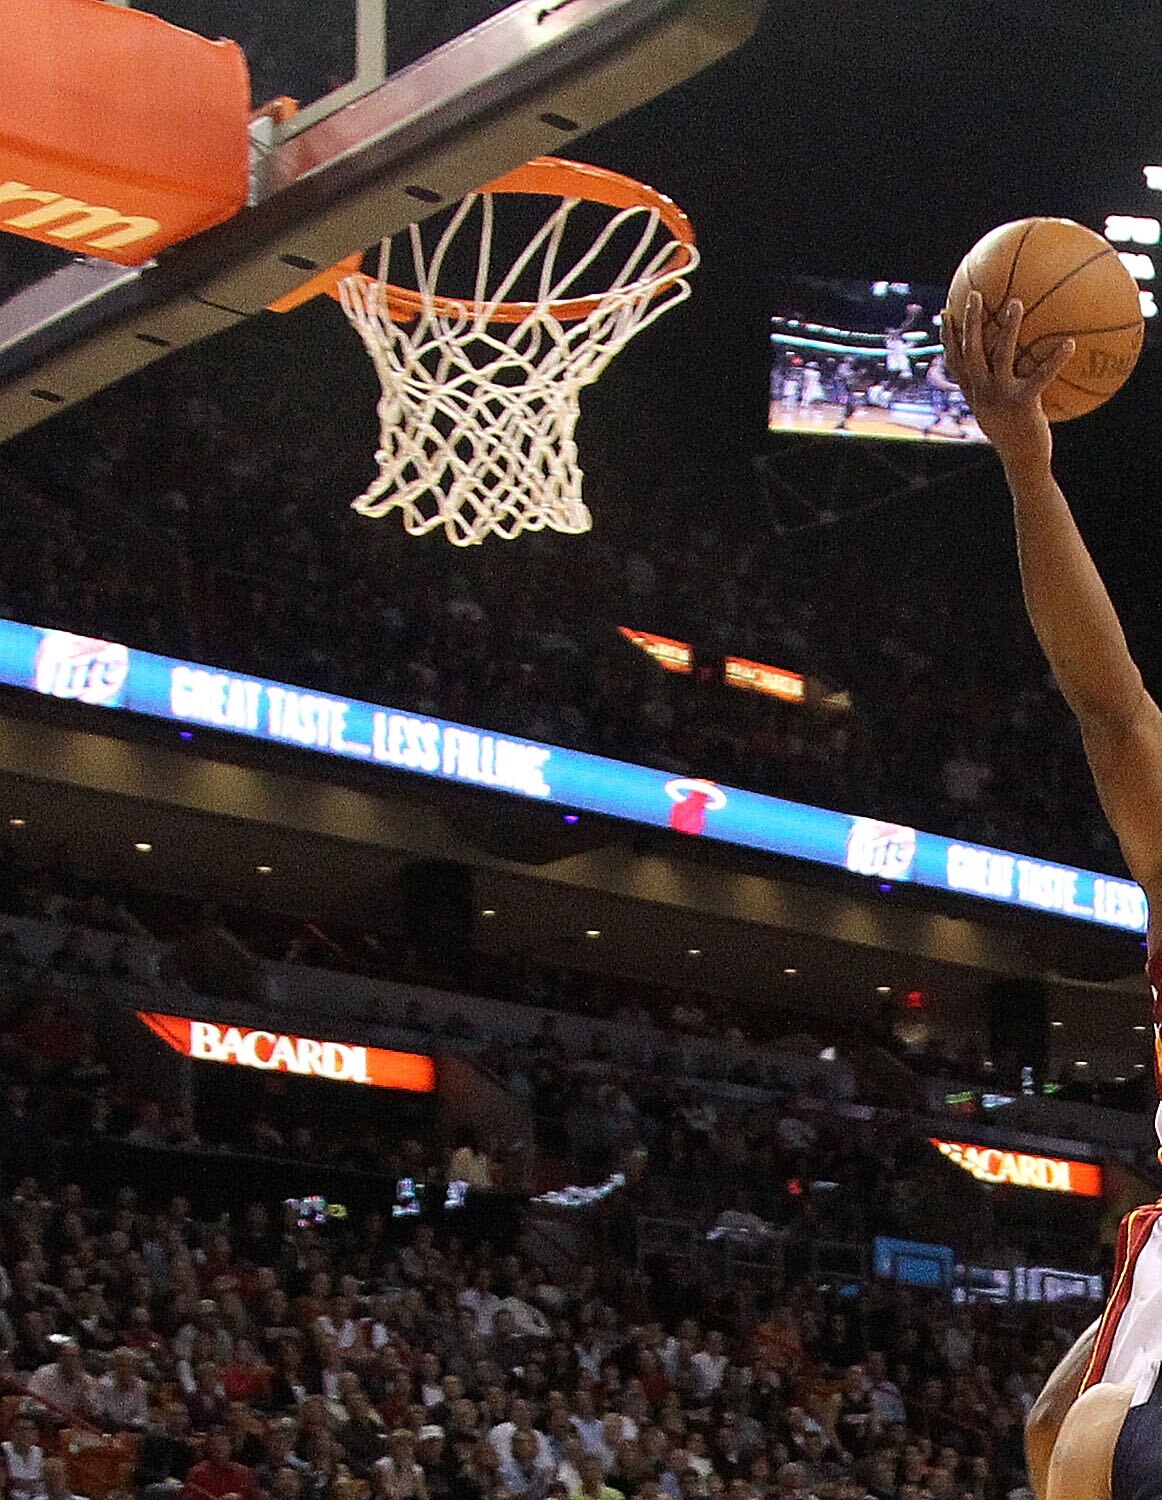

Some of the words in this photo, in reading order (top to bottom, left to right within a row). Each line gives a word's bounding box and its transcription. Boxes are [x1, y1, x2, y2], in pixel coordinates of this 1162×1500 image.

[171, 667, 261, 729] GREAT
[373, 712, 440, 770] LESS
[190, 1021, 371, 1083] BACARDI
